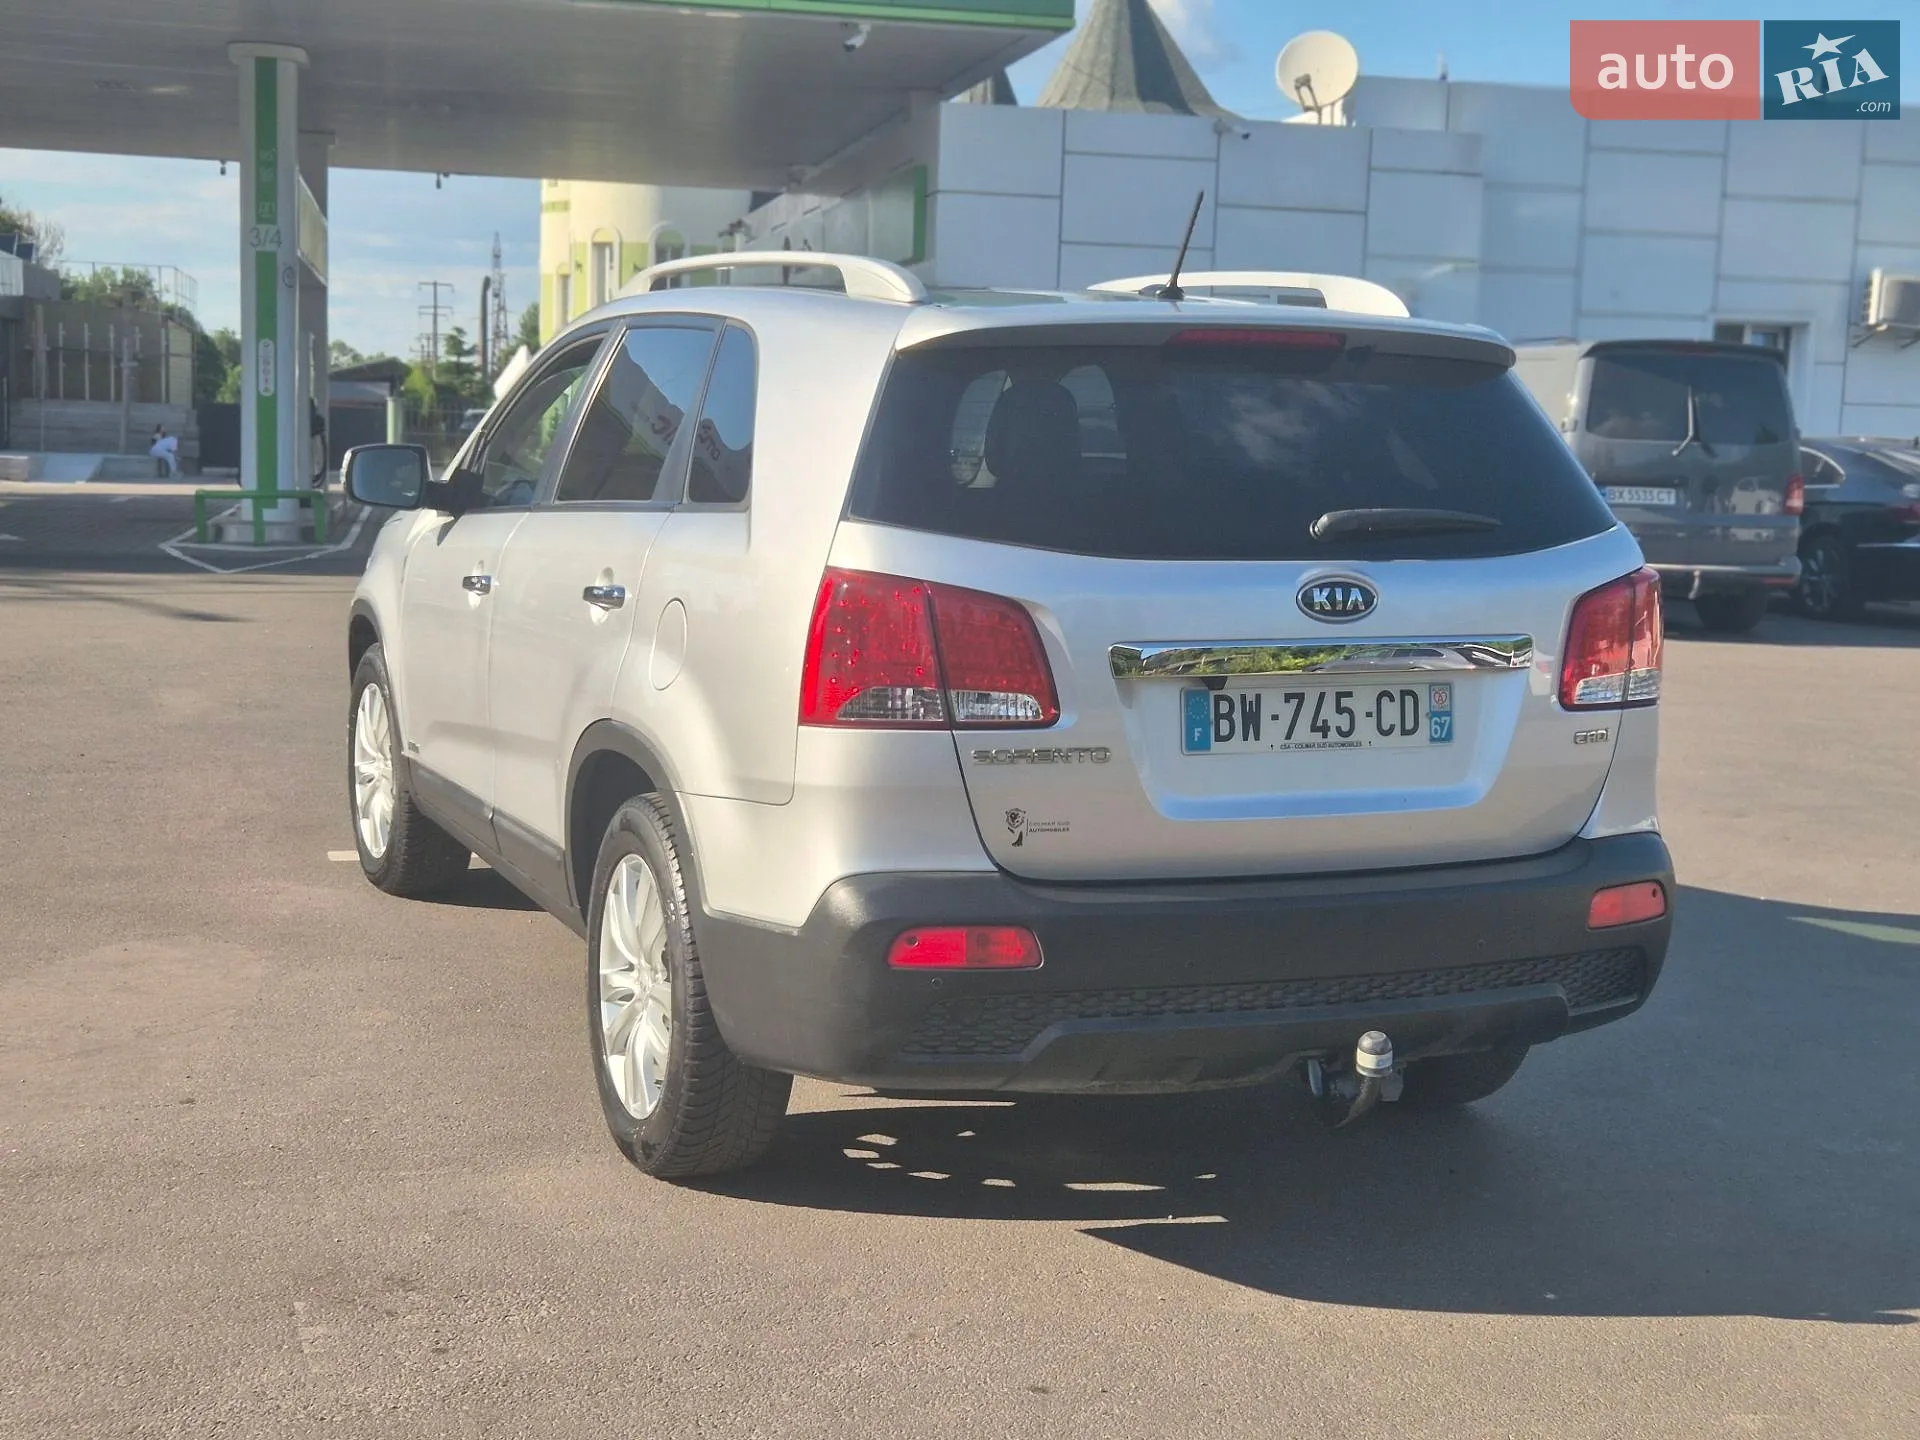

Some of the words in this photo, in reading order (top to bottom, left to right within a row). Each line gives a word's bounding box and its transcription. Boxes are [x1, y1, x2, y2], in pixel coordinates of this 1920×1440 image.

[250, 227, 282, 249] 3/4
[1312, 587, 1365, 611] KIA
[1213, 689, 1420, 742] BW-745-CD
[1194, 727, 1202, 742] F
[1431, 716, 1450, 738] 67
[971, 746, 1111, 765] SORENTO
